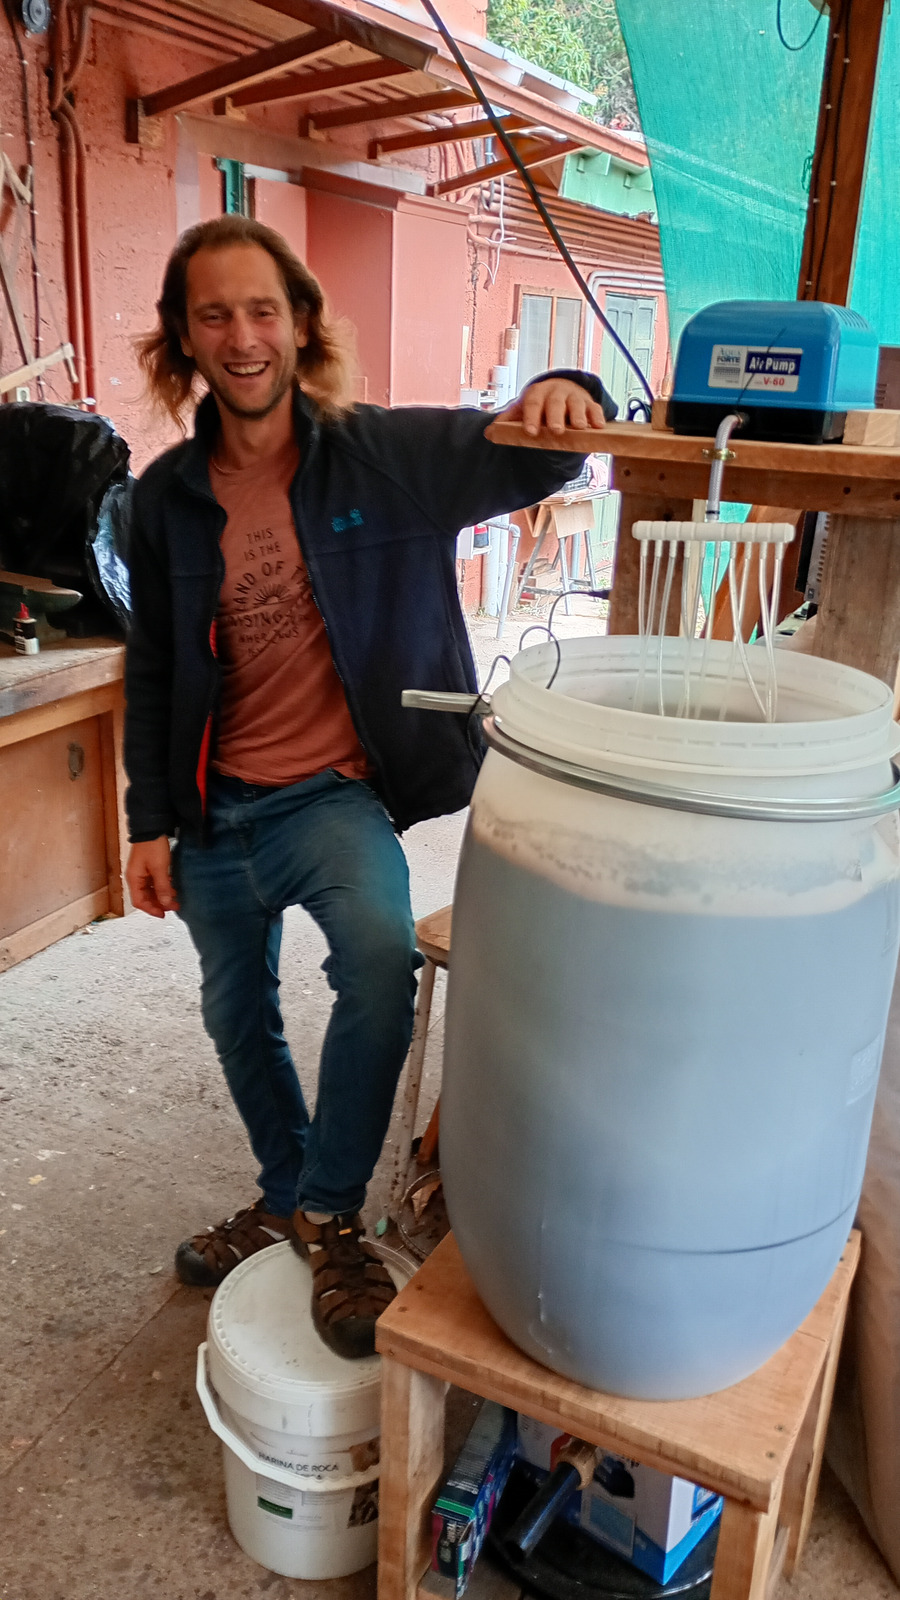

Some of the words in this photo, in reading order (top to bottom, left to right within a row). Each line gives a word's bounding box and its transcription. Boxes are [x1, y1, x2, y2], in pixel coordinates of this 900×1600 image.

[749, 356, 764, 370] Air
[765, 357, 796, 374] Pump
[763, 377, 785, 386] V-60
[247, 528, 273, 543] THIS
[244, 549, 256, 561] IS
[259, 542, 281, 556] THE
[261, 560, 285, 576] OF
[311, 1464, 339, 1472] ROCA
